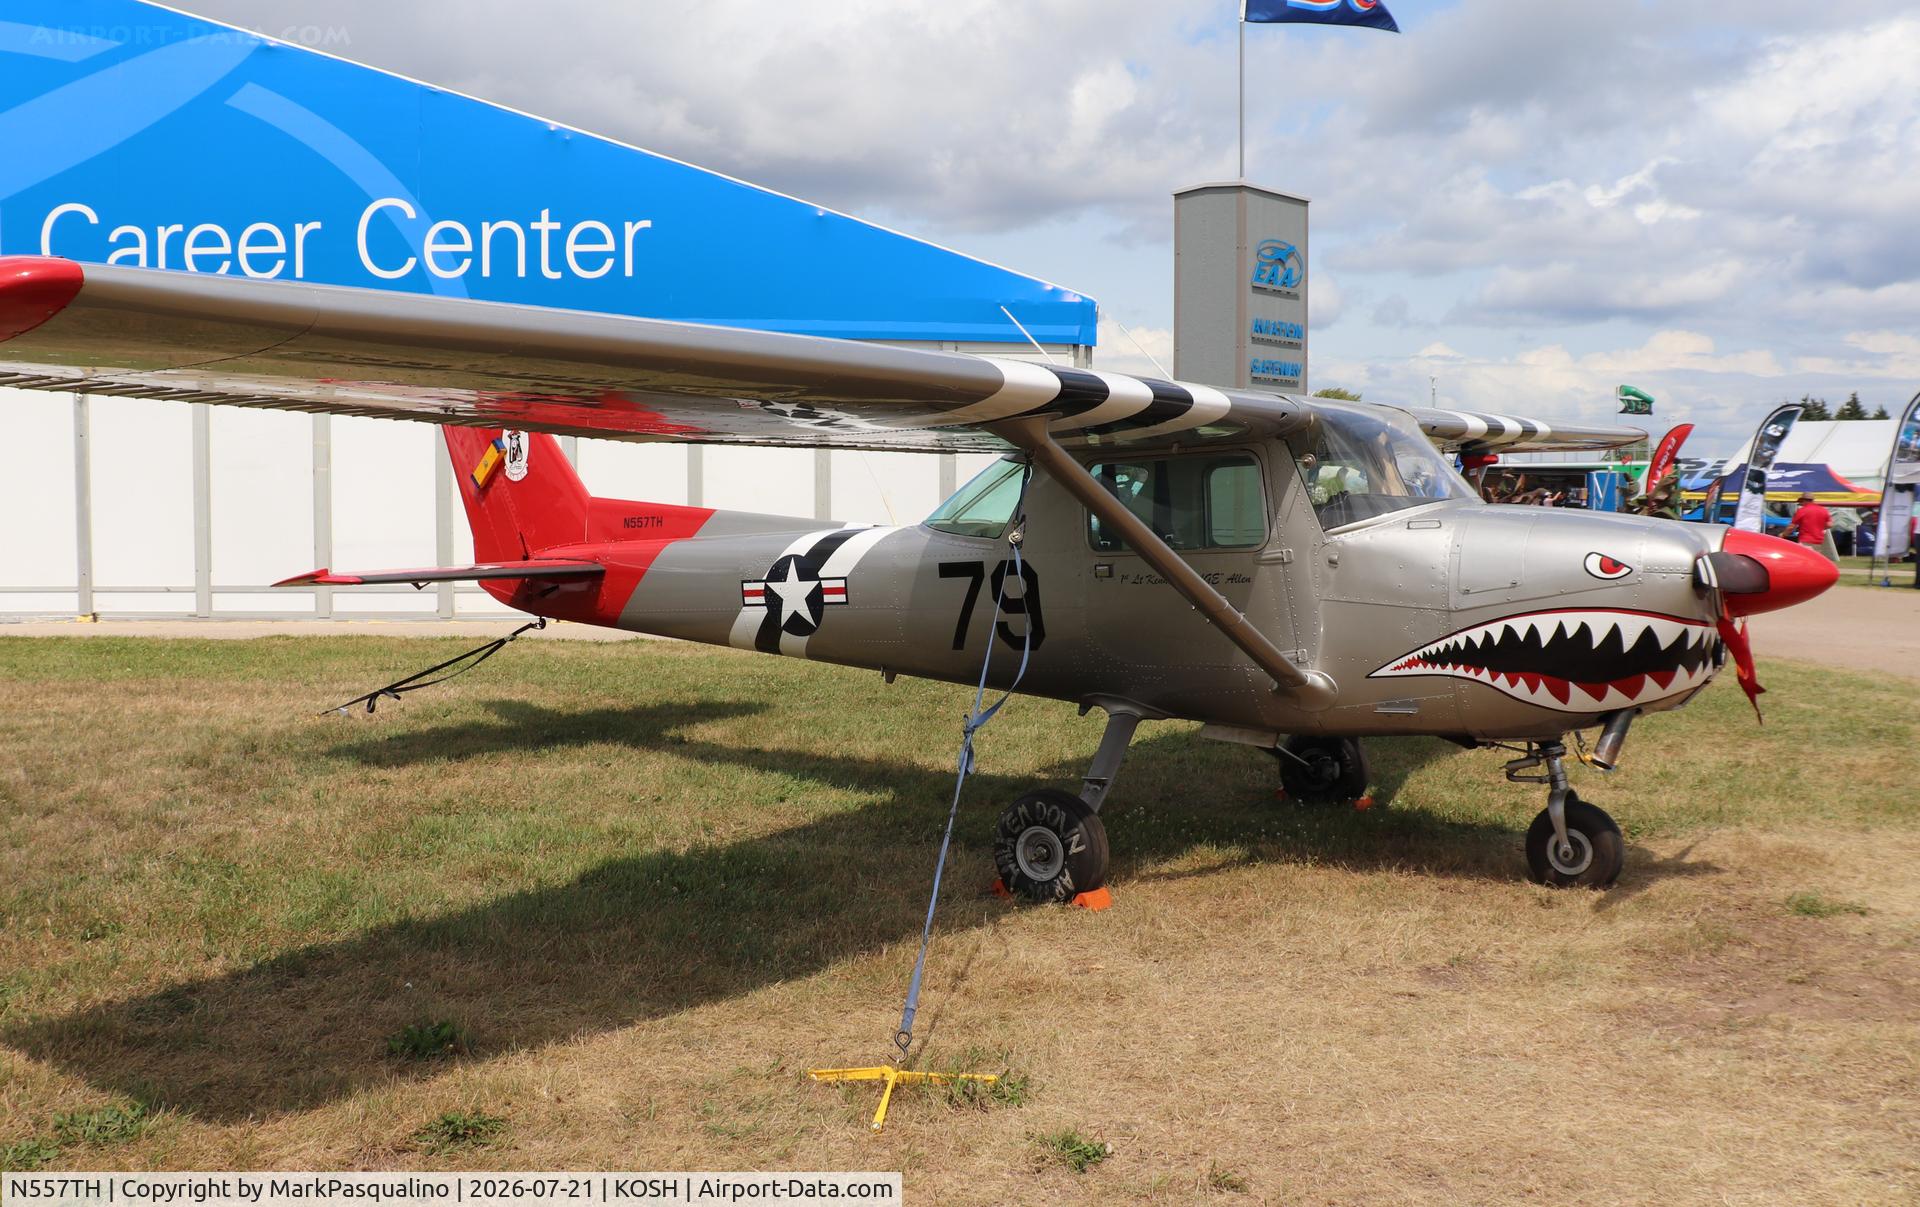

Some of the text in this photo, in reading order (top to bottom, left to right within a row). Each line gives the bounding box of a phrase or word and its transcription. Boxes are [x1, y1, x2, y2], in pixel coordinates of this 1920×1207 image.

[41, 198, 652, 279] Career Center
[1253, 262, 1294, 288] EAA
[1253, 318, 1303, 339] AVIATION
[1251, 359, 1302, 378] GATEWAY
[623, 516, 664, 529] N557TH
[1225, 572, 1252, 585] Allen
[938, 559, 1046, 651] 79
